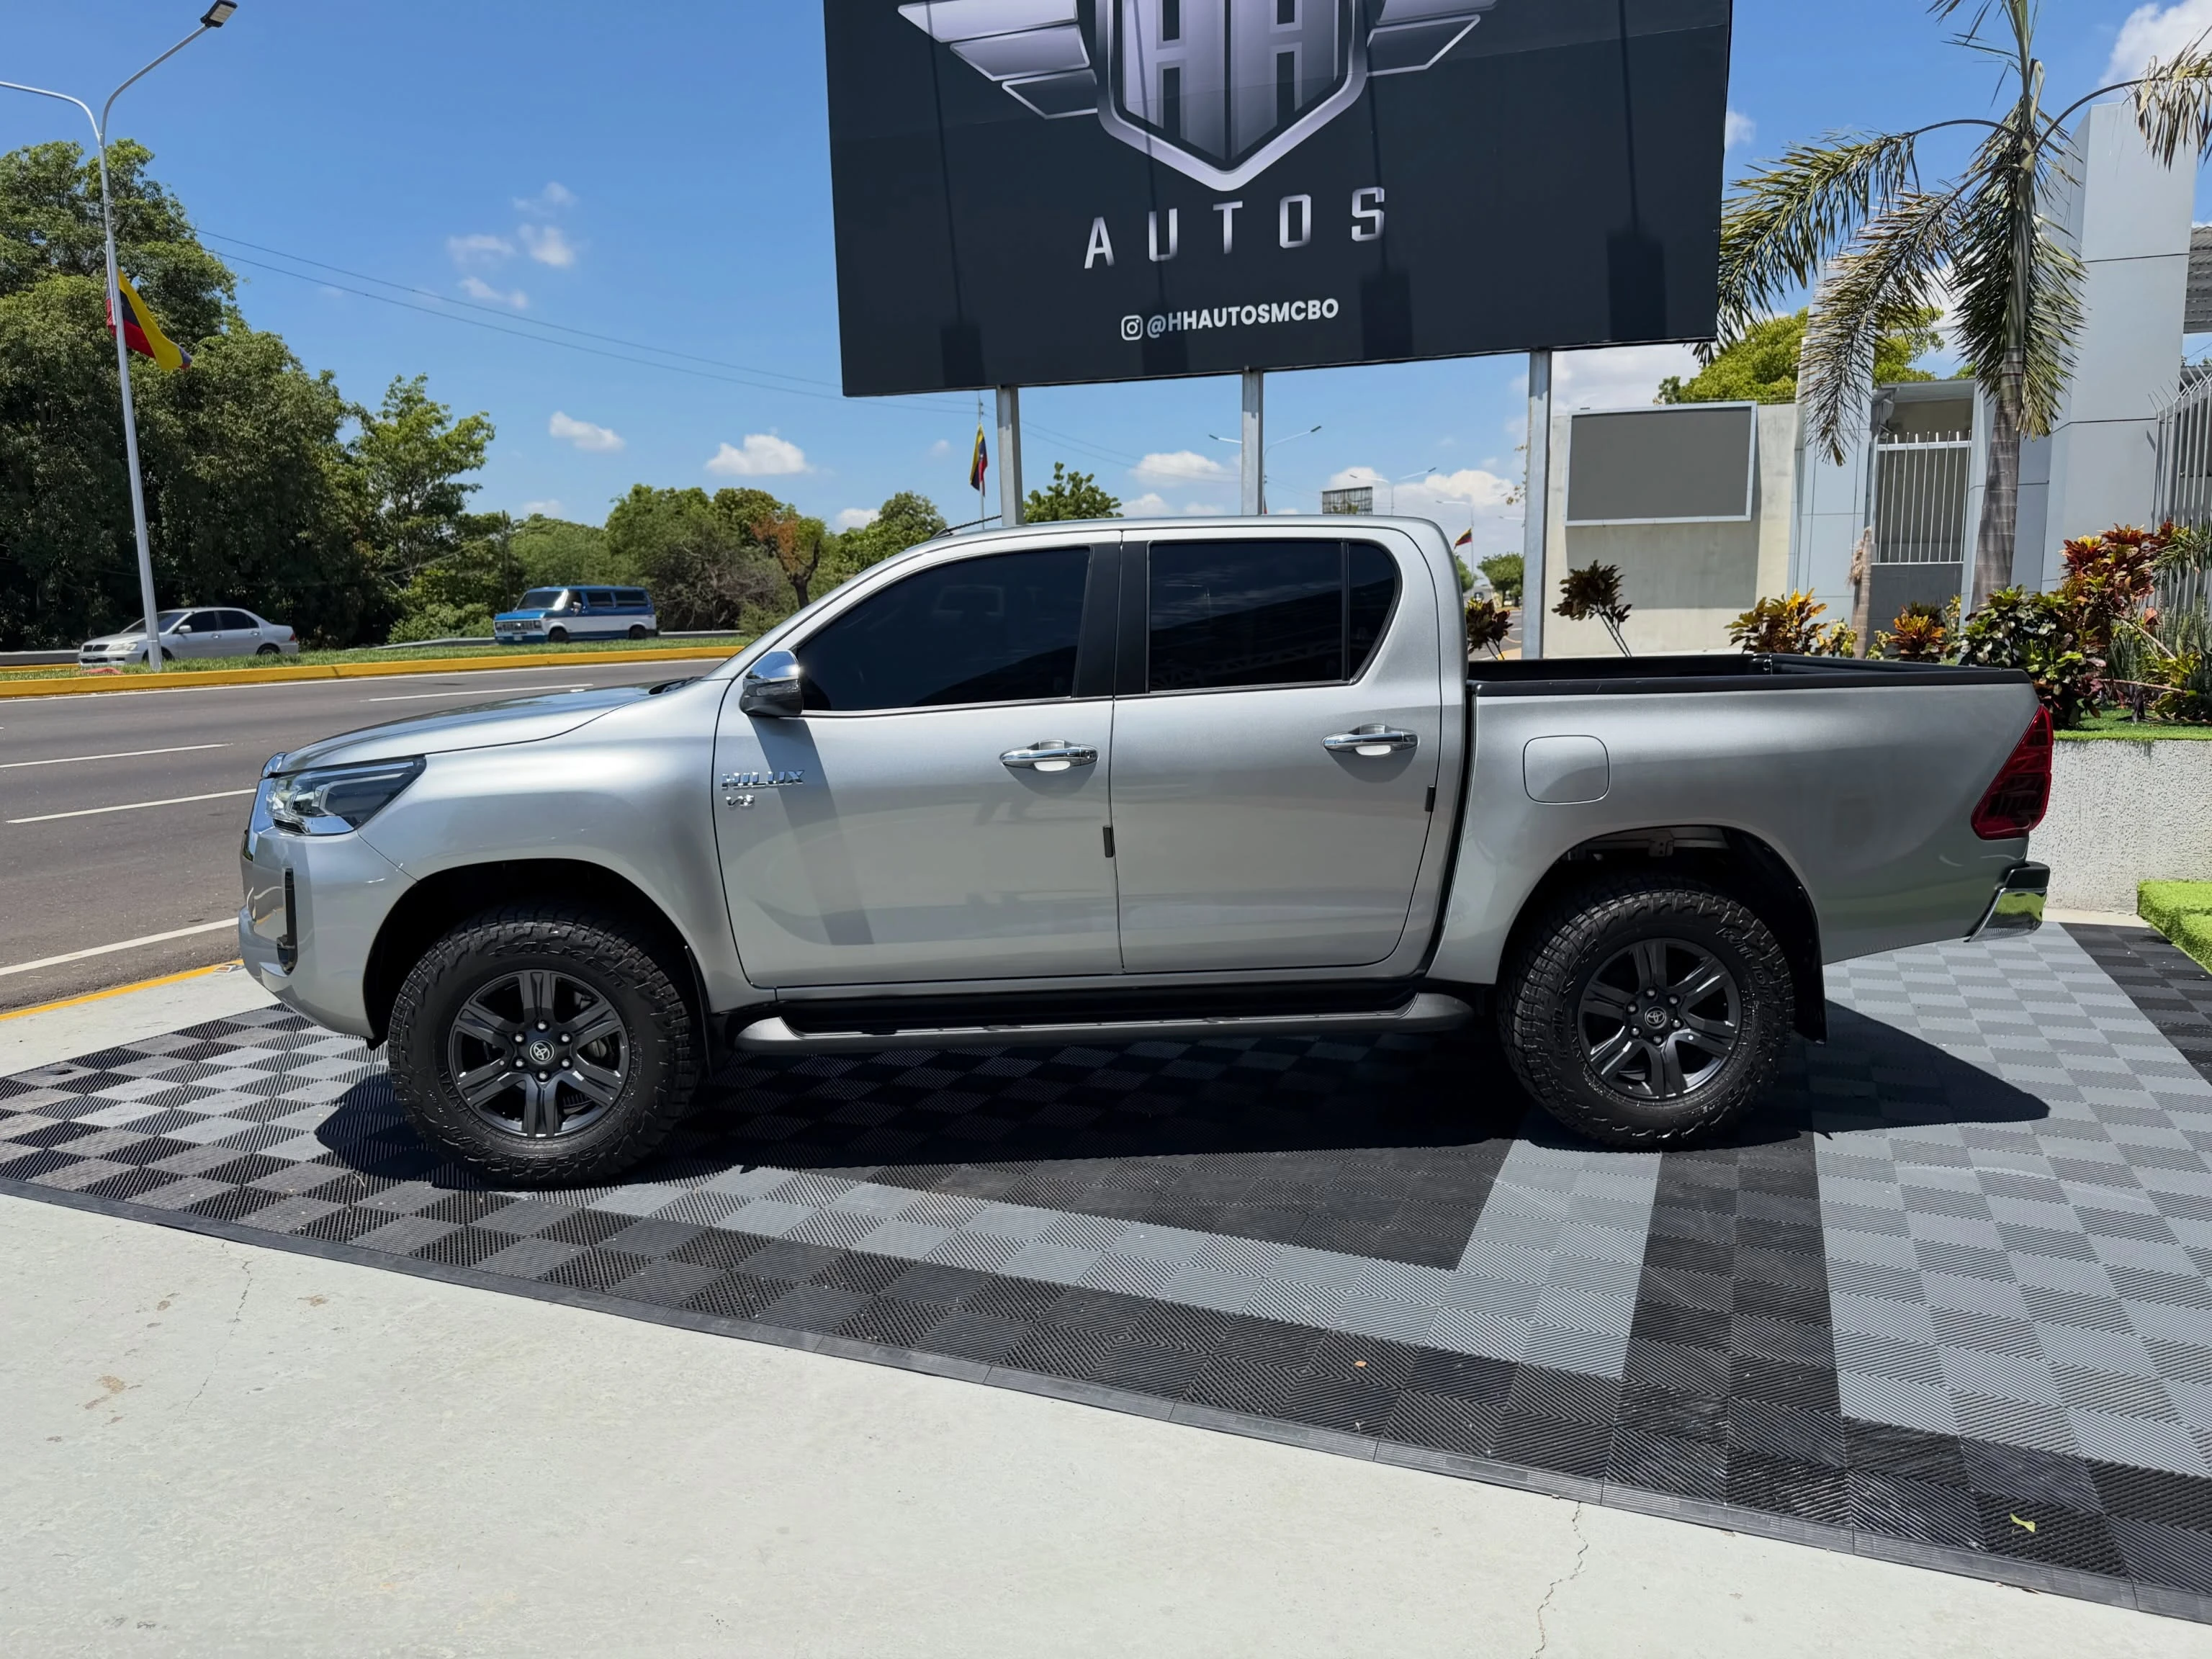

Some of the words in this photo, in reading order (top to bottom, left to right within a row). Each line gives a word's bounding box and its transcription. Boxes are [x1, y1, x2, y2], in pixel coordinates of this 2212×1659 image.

[1084, 186, 1385, 269] AUTOS
[1146, 298, 1339, 338] @HHAUTOSMCBO
[721, 769, 805, 790] HILUX
